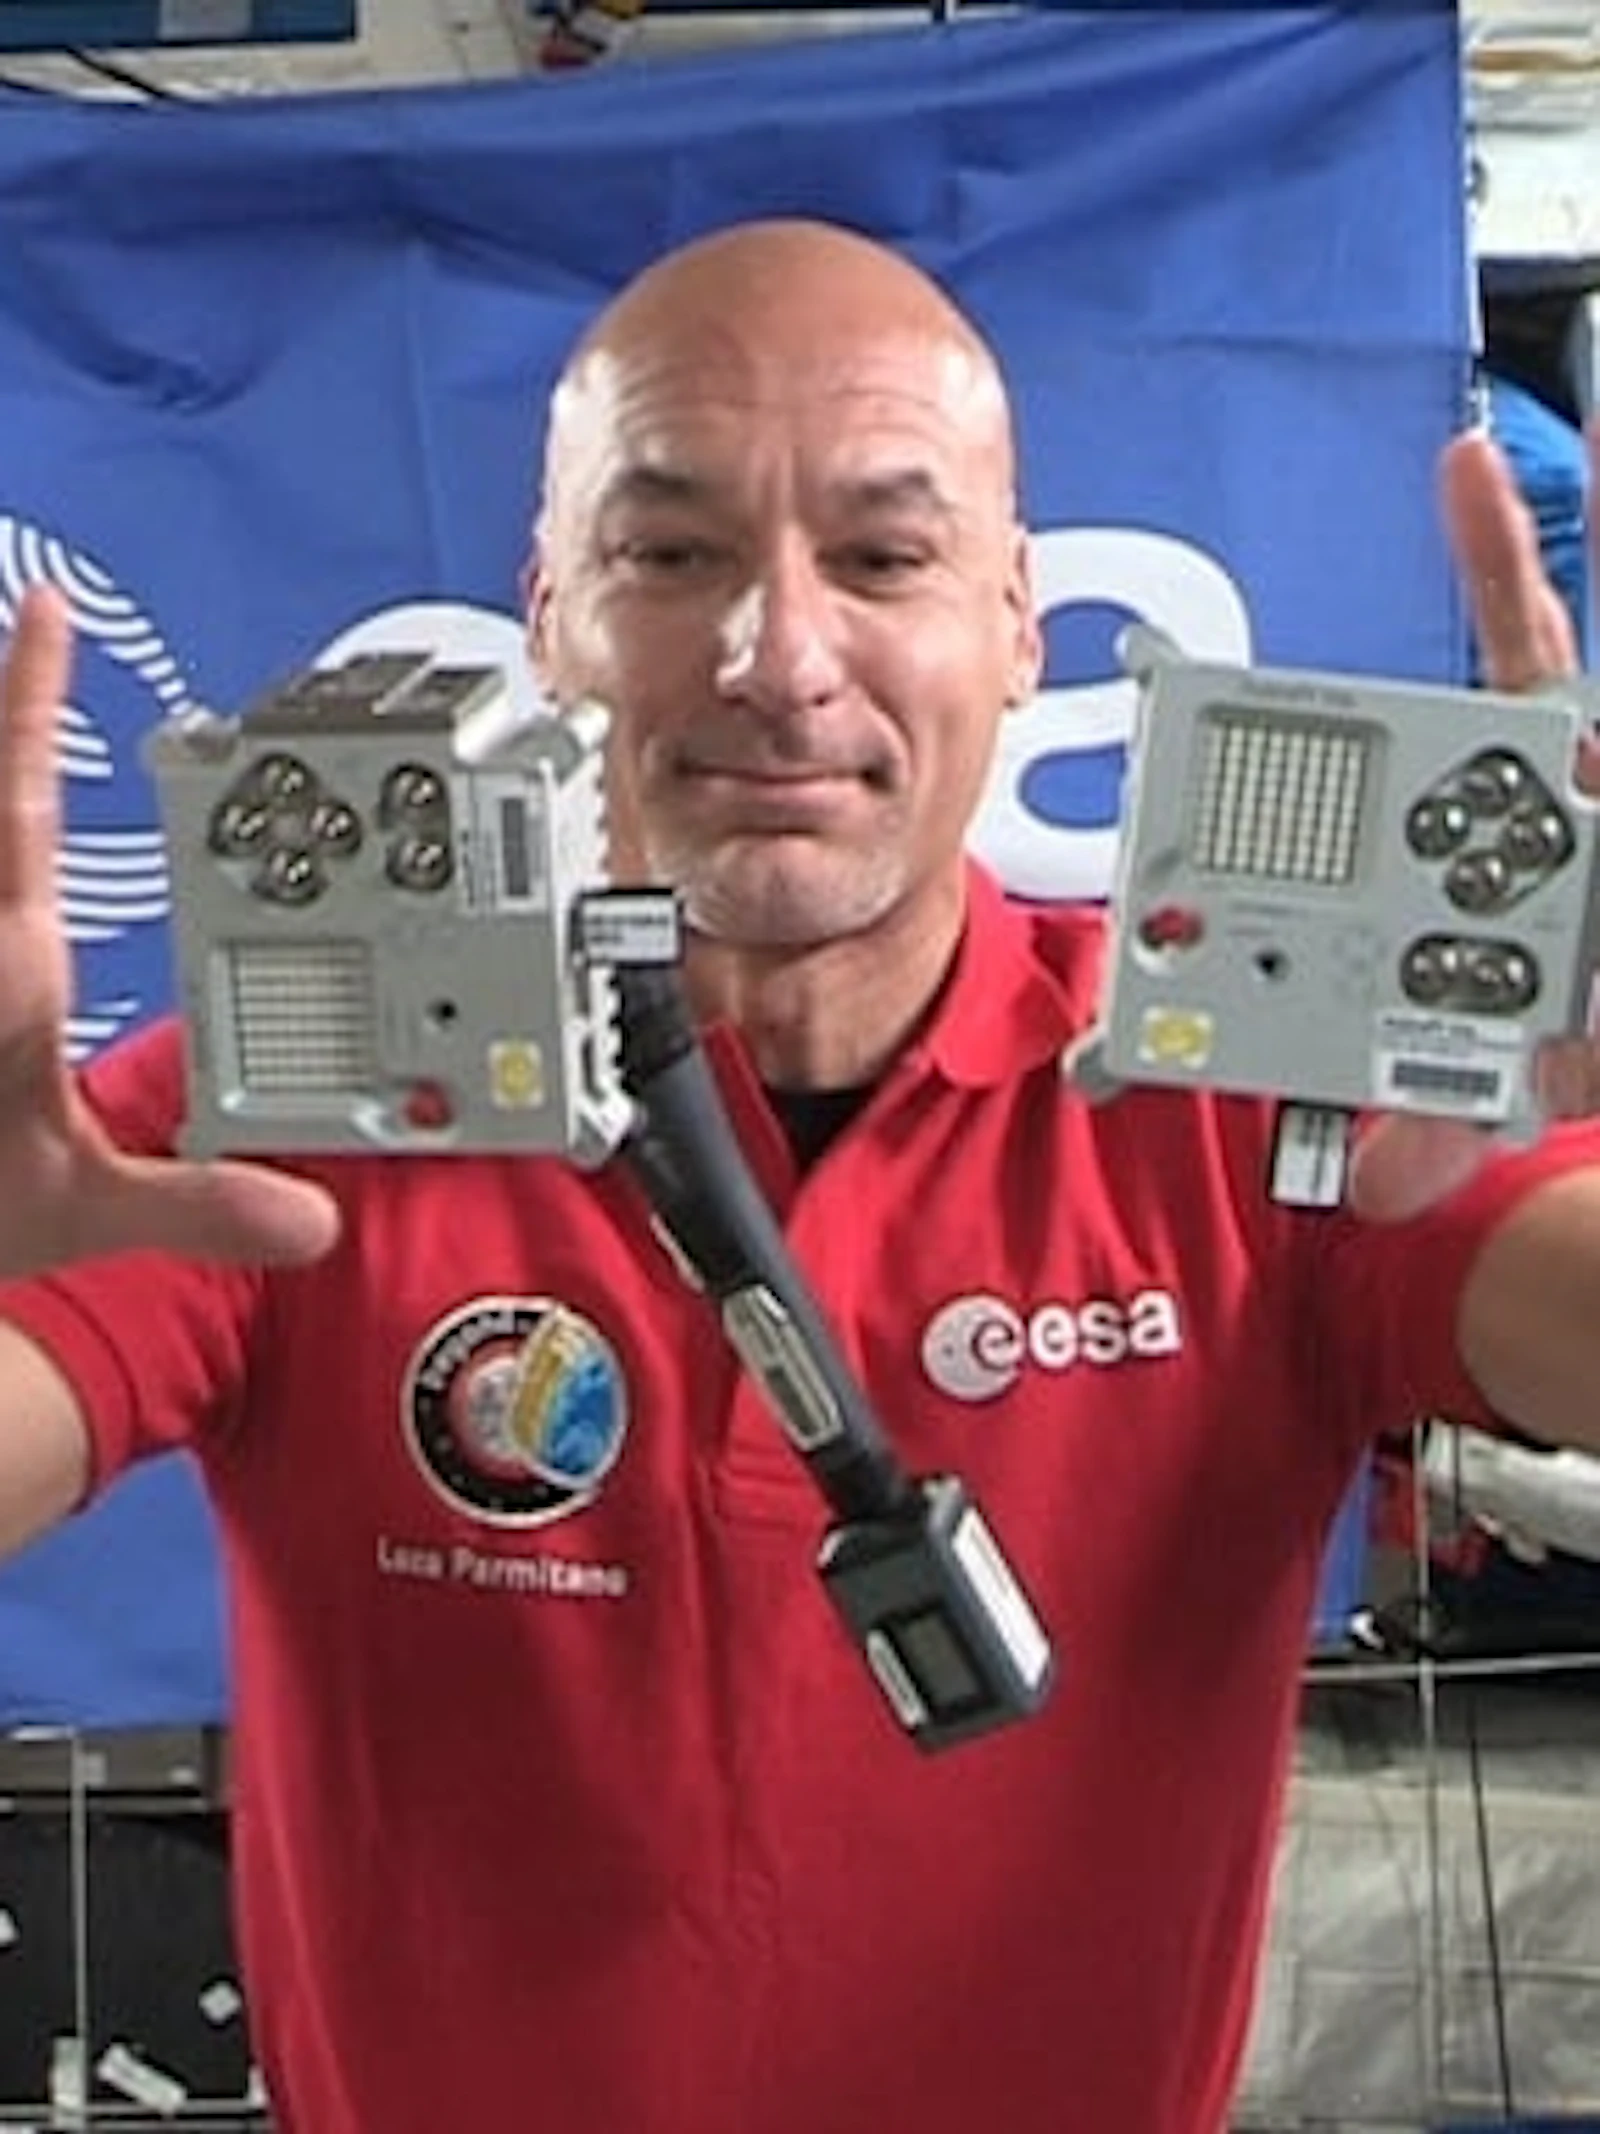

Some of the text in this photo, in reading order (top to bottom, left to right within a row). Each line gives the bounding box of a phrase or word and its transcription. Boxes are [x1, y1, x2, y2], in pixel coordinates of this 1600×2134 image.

[1029, 1289, 1181, 1368] esa
[378, 1534, 627, 1597] Luca Parmitano
